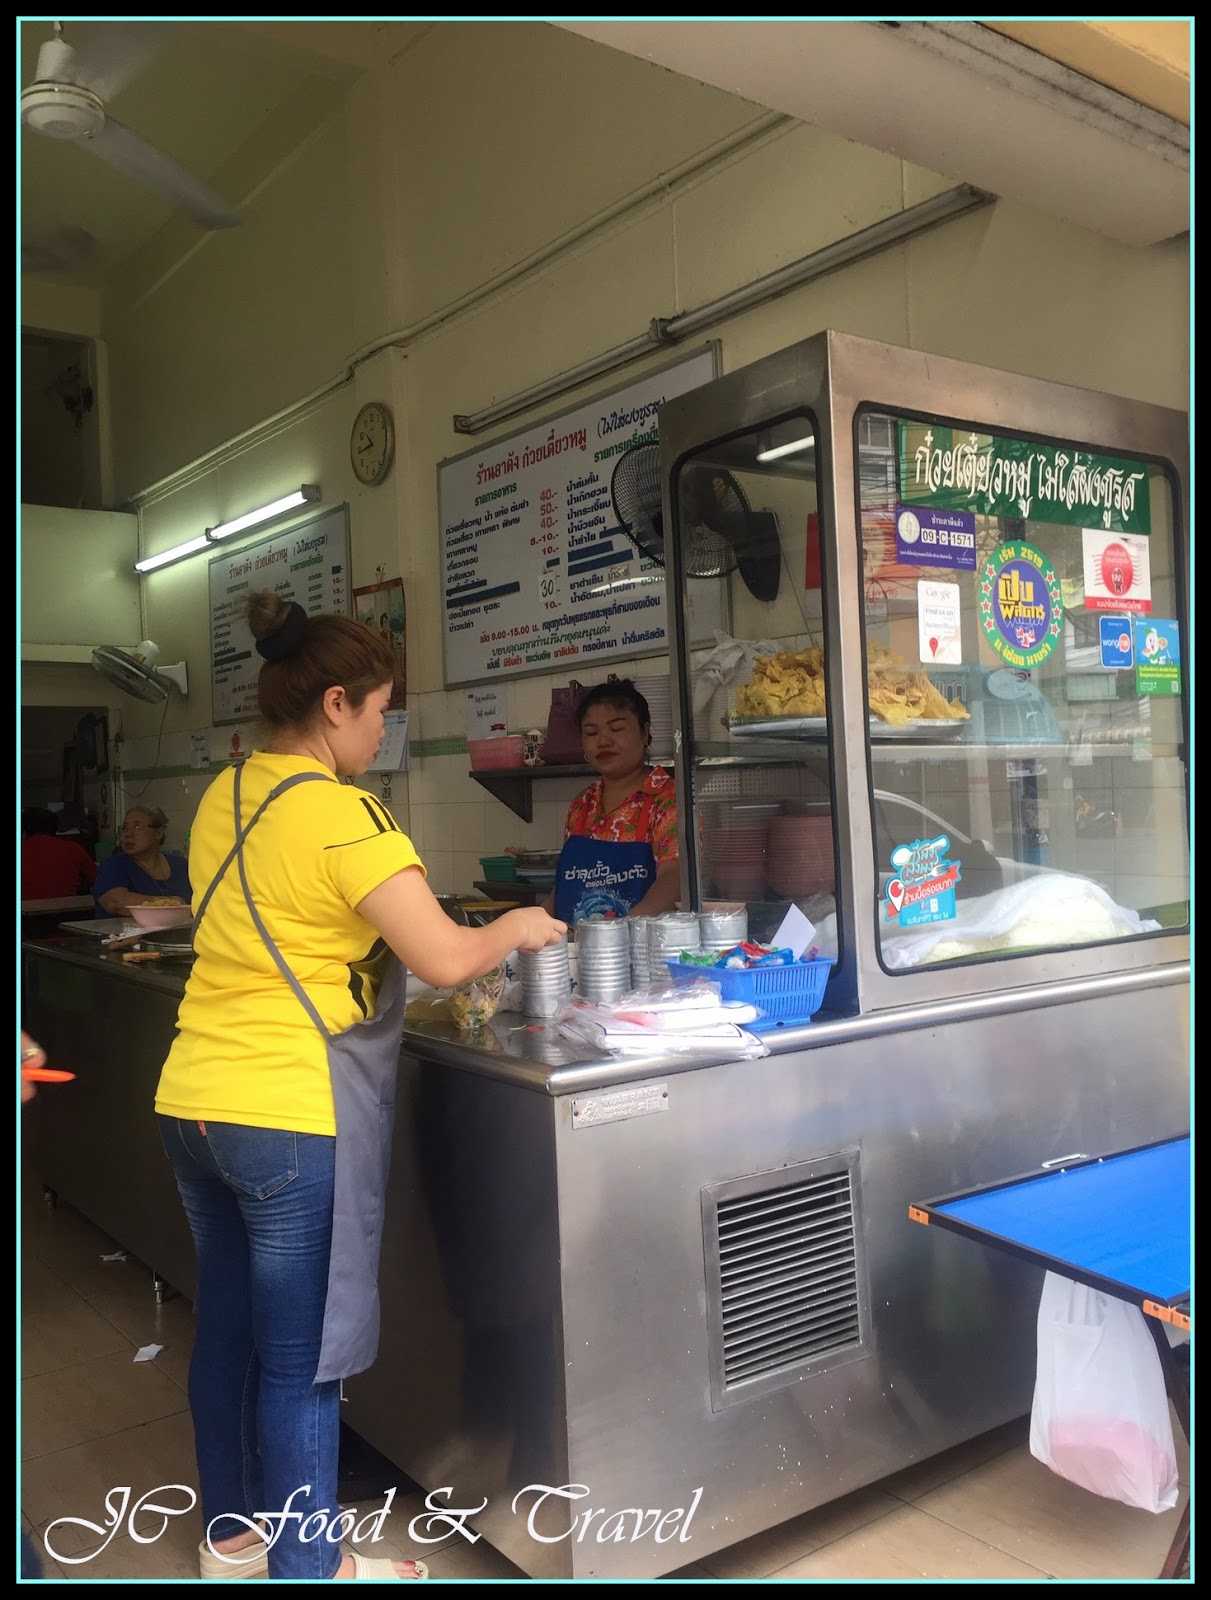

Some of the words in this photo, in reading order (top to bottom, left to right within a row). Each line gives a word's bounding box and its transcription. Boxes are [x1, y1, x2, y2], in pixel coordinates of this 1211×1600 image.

[566, 472, 599, 492] น้ำส้มคั้น
[915, 430, 1034, 518] ก๋วยเตี๋ยวหมู
[1037, 450, 1144, 529] ไม่ใส่ผงชูรส
[475, 482, 518, 506] รายการอาหาร
[540, 489, 558, 502] 40.-
[540, 503, 558, 516] 50.-
[540, 517, 559, 529] 40.-
[1020, 546, 1043, 568] 2519
[540, 579, 554, 598] 30
[570, 573, 604, 590] ชาดำเย็น
